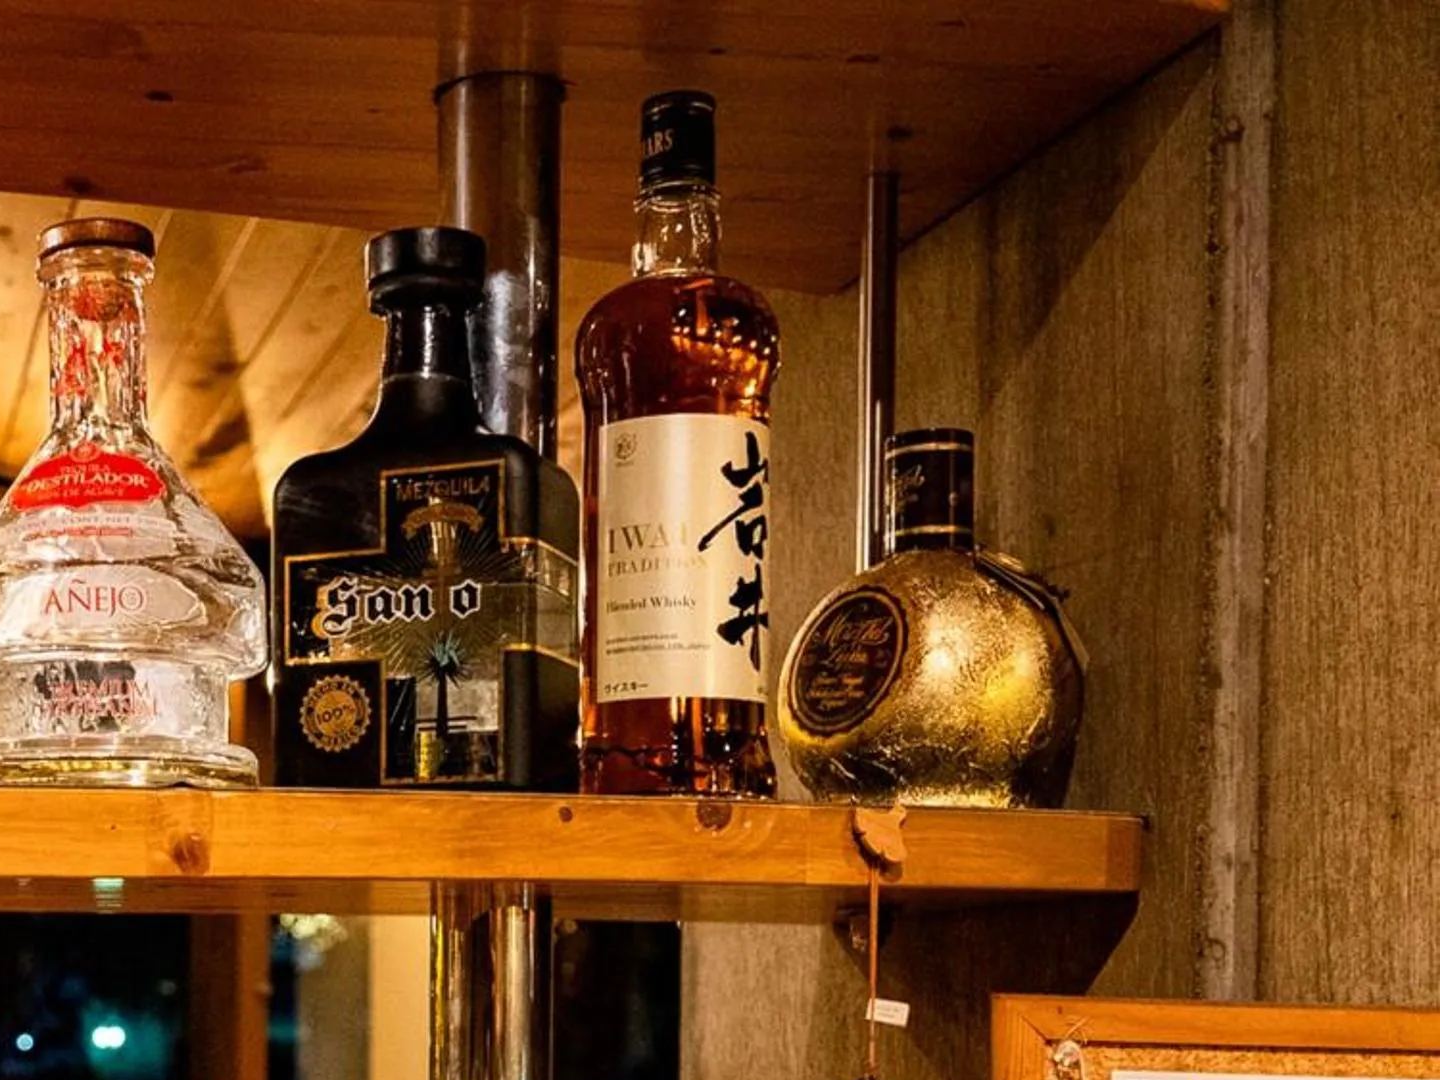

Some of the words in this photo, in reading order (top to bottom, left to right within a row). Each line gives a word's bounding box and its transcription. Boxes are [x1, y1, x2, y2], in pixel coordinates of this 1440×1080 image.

[26, 471, 151, 494] DESTILADOR
[608, 521, 688, 554] IWAI
[45, 578, 144, 617] AÑEJO
[650, 595, 697, 612] Whisky
